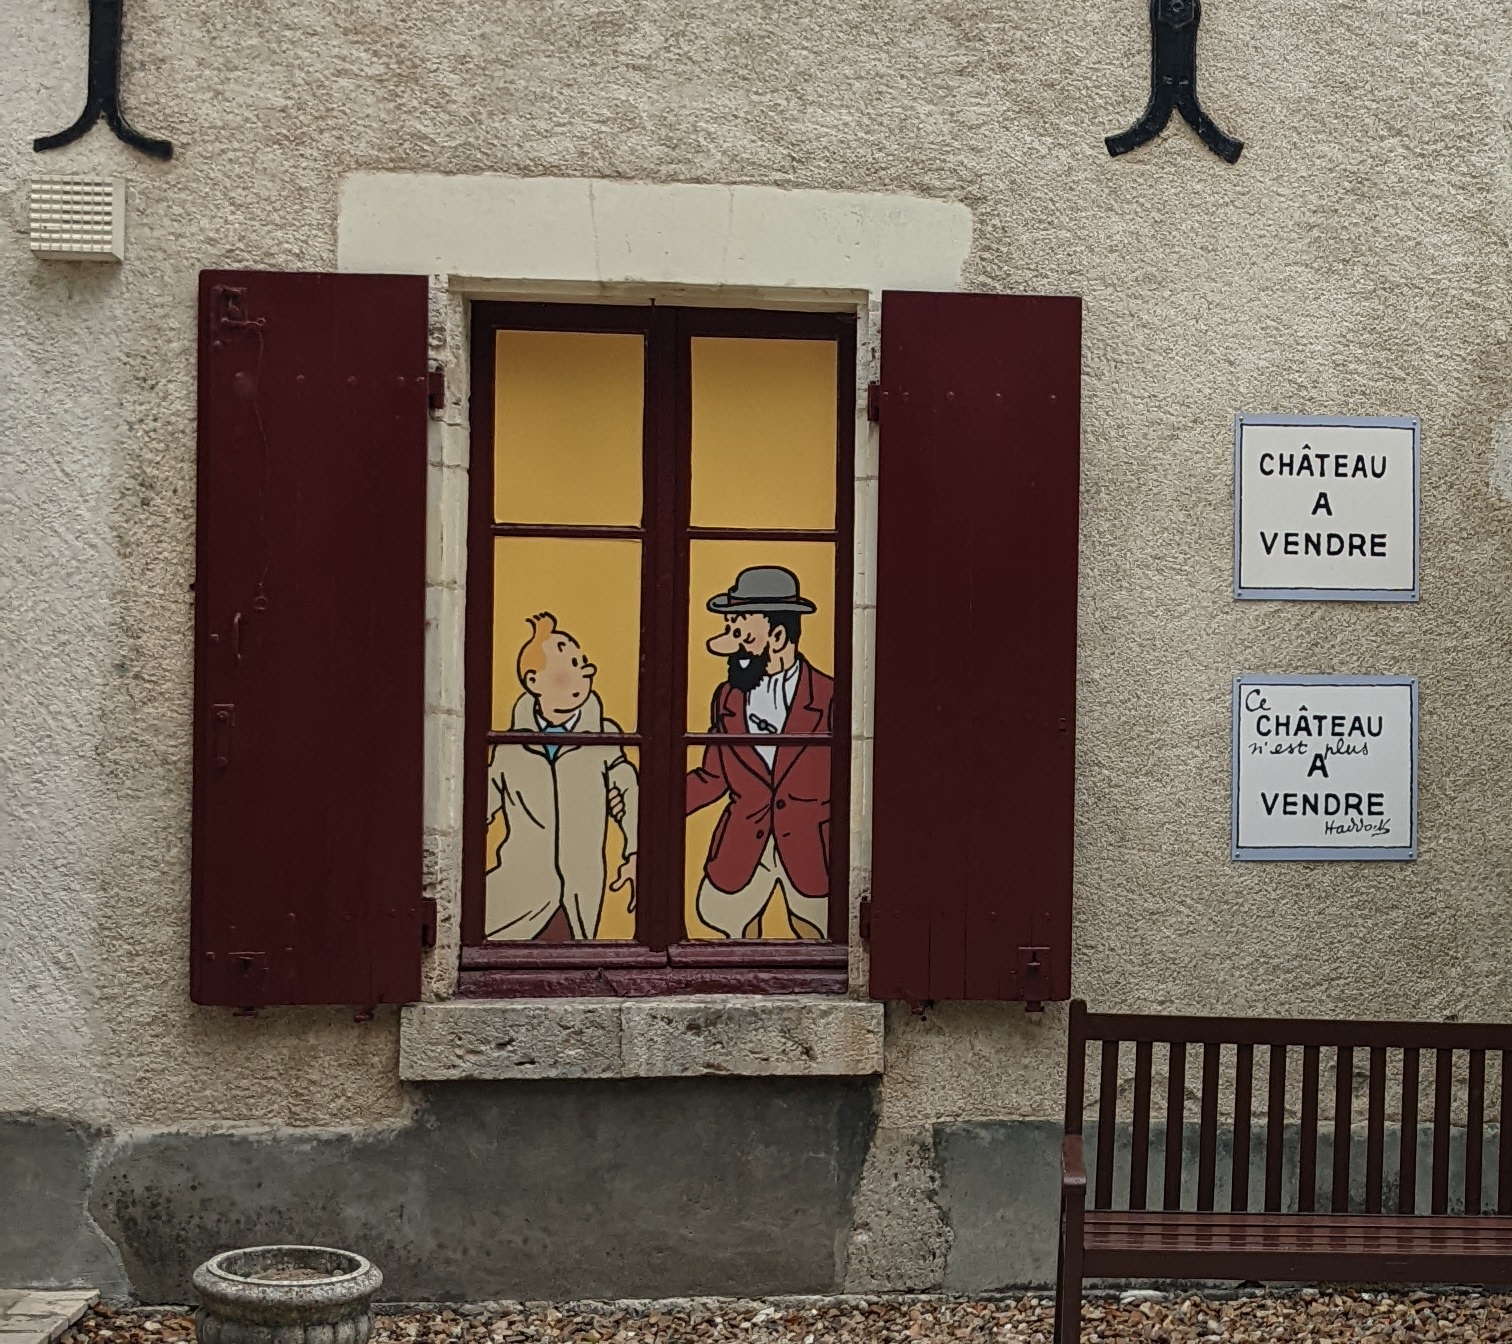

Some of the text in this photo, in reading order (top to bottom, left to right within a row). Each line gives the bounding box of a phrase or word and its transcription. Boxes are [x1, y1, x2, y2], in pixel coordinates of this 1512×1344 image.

[1259, 444, 1387, 478] CHÂTEAU
[1311, 492, 1333, 516] A
[1260, 531, 1388, 557] VENDRE
[1245, 689, 1271, 712] Ce
[1256, 704, 1383, 737] CHÂTEAU
[1248, 738, 1369, 760] n'est plus
[1307, 753, 1329, 778] A
[1260, 792, 1385, 816] VENDRE
